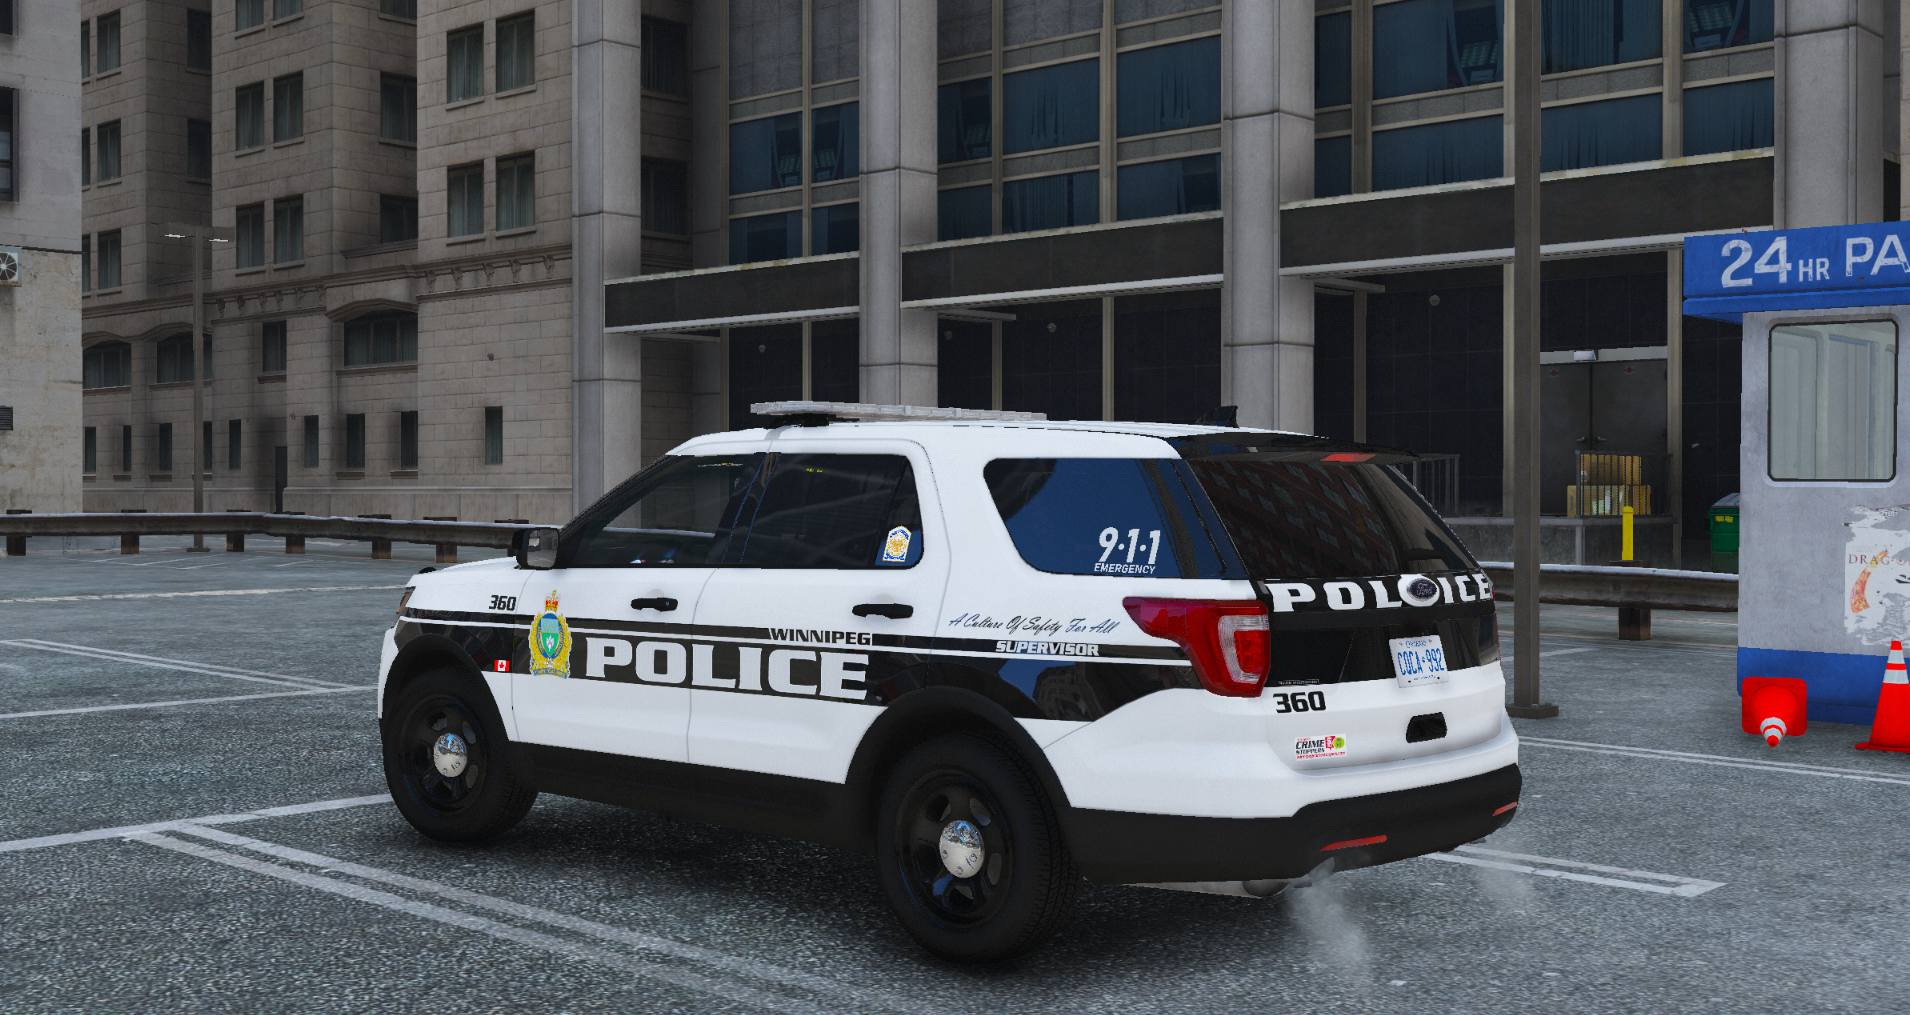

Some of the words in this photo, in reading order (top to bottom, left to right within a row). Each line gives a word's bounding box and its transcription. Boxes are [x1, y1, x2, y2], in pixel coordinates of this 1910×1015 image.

[1721, 236, 1792, 288] 24
[1799, 258, 1830, 282] HR
[1094, 563, 1156, 574] EMERGENCY
[489, 594, 517, 611] 360
[948, 612, 968, 627] A
[964, 613, 1004, 628] Culture
[1006, 615, 1027, 635] Of
[1023, 616, 1063, 637] Safety
[1065, 618, 1087, 633] For
[1089, 618, 1121, 634] All
[769, 628, 871, 646] WINNIPEG
[996, 641, 1100, 656] SUPERVISOR
[585, 636, 869, 700] POLICE
[1273, 690, 1326, 714] 360
[1296, 740, 1325, 750] CRIME
